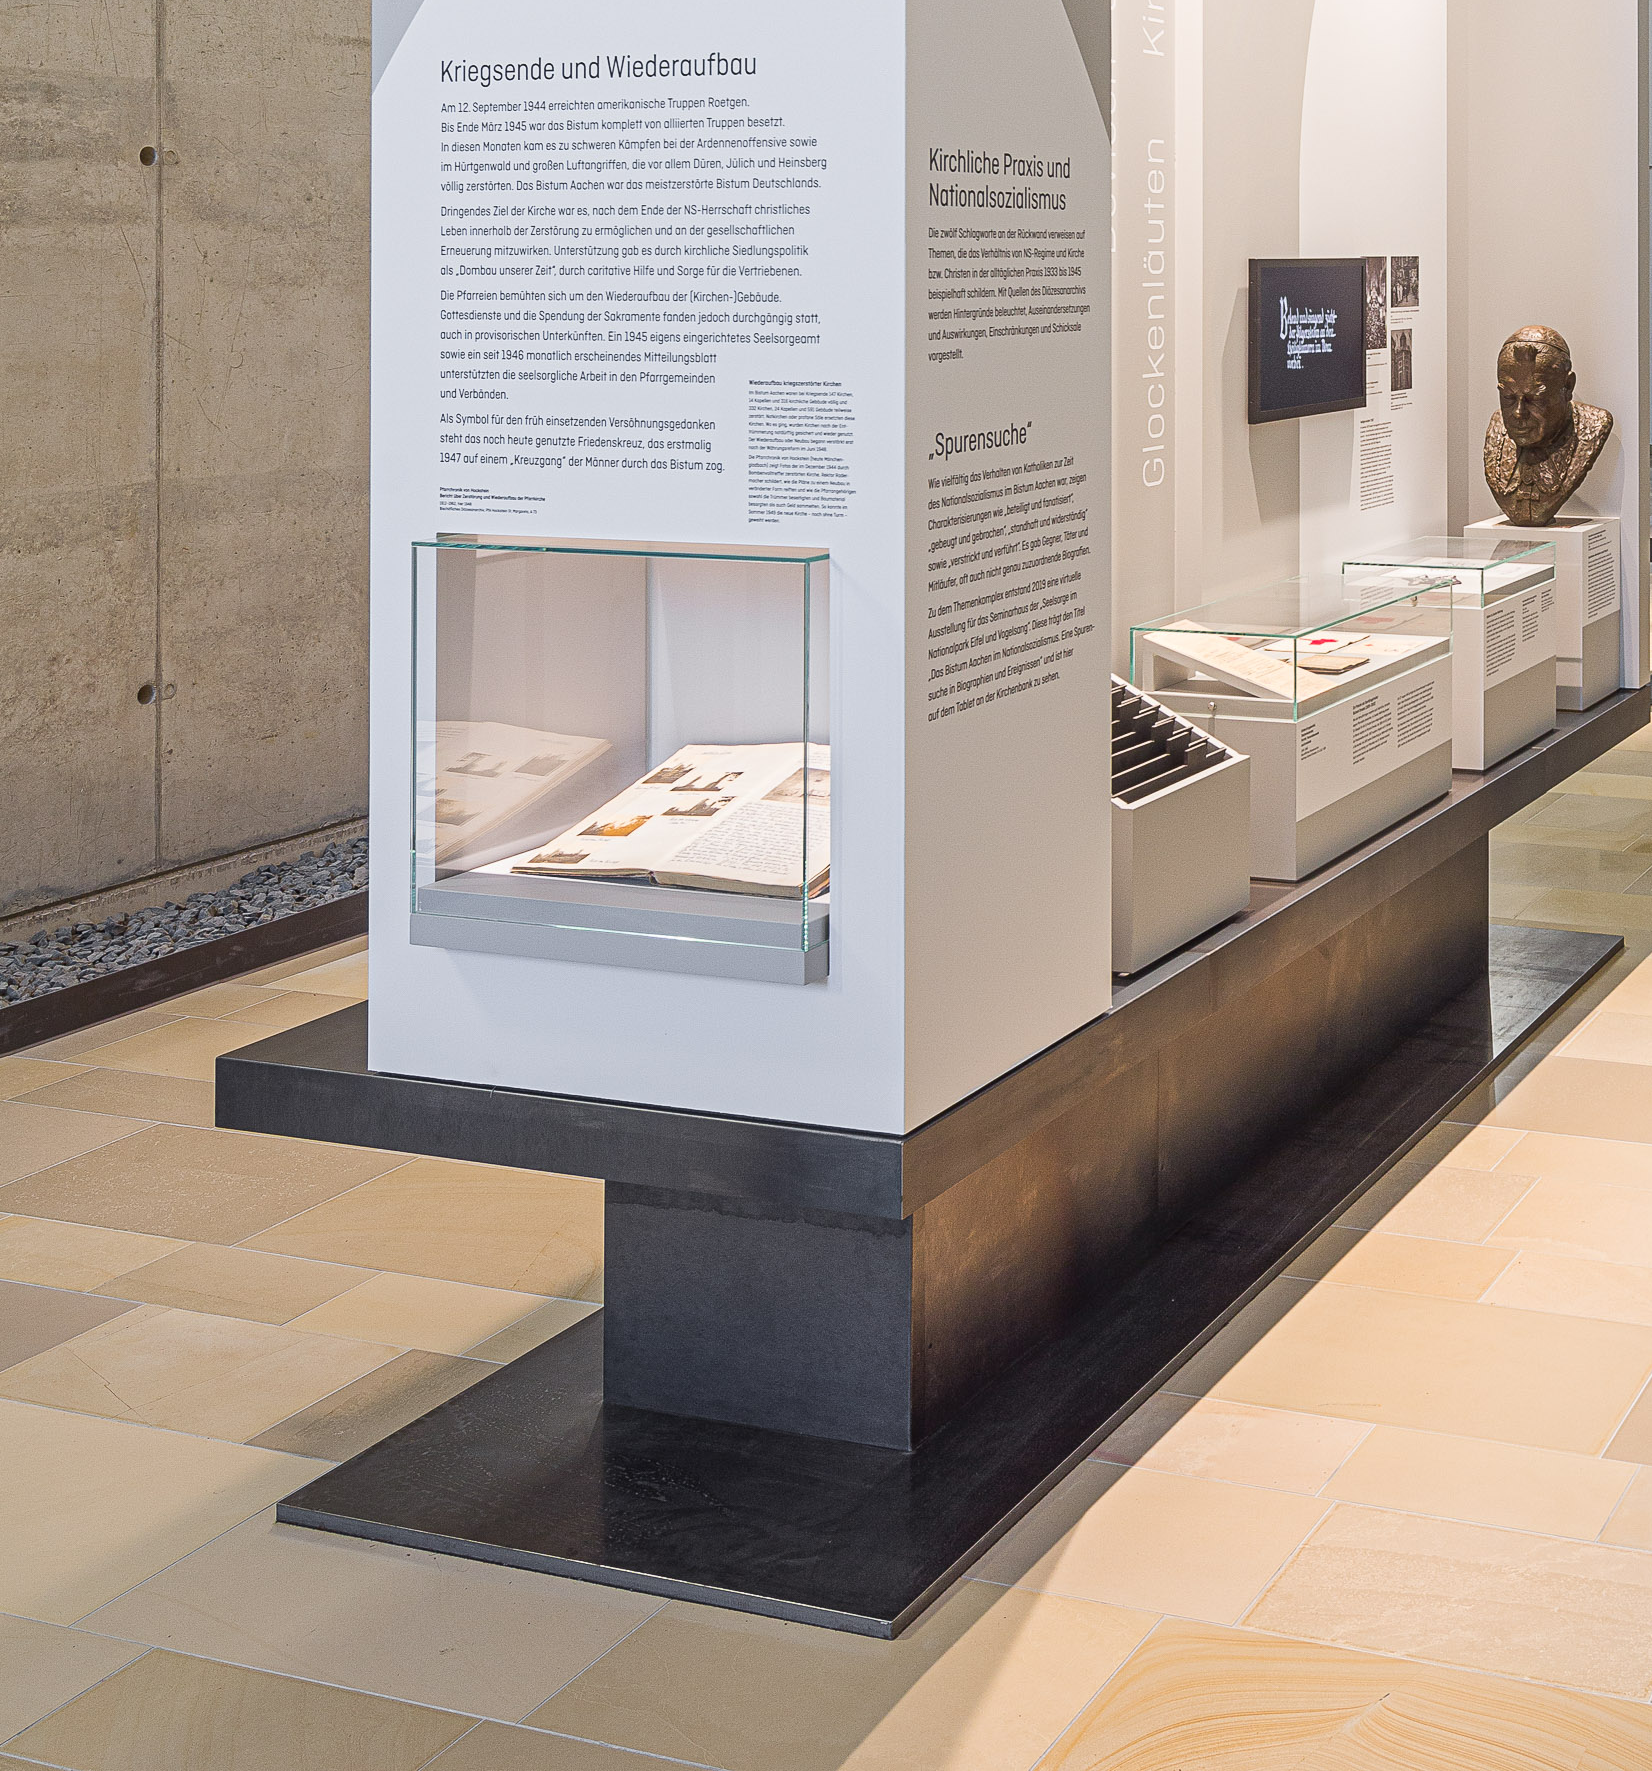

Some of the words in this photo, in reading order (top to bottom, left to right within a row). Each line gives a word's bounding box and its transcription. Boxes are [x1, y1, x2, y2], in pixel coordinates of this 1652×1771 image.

[441, 57, 554, 87] Kriegsende
[562, 55, 599, 79] und
[606, 52, 755, 77] Wiederaufbau
[441, 103, 455, 112] Am
[458, 102, 470, 112] 12.
[472, 101, 521, 114] September
[524, 100, 545, 111] 1944
[548, 100, 594, 110] erreichten
[597, 98, 665, 109] amerikanische
[667, 98, 705, 110] Truppen
[708, 97, 749, 109] Roetgen.
[441, 122, 454, 132] Bis
[457, 122, 478, 132] Ende
[481, 121, 502, 131] März
[505, 120, 526, 131] 1945
[529, 122, 545, 130] war
[548, 120, 564, 130] das
[567, 120, 598, 130] Bistum
[601, 119, 642, 131] komplett
[644, 120, 661, 128] von
[664, 118, 704, 128] alliierten
[706, 117, 744, 129] Truppen
[747, 117, 784, 127] besetzt.
[441, 142, 449, 151] In
[451, 142, 480, 152] diesen
[483, 142, 521, 151] Monaten
[524, 141, 543, 150] kam
[546, 142, 556, 150] es
[559, 142, 569, 150] zu
[571, 140, 615, 150] schweren
[619, 138, 660, 151] Kämpfen
[663, 138, 676, 148] bei
[680, 138, 694, 148] der
[697, 136, 786, 148] Ardennenoffensive
[789, 136, 817, 147] sowie
[441, 162, 451, 171] im
[454, 160, 510, 174] Hürtgenwald
[513, 161, 530, 170] und
[533, 160, 563, 173] großen
[566, 159, 629, 172] Luftangriffen,
[632, 159, 645, 169] die
[648, 161, 662, 169] vor
[665, 159, 690, 168] allem
[693, 158, 723, 169] Düren,
[726, 158, 754, 168] Jülich
[758, 157, 775, 167] und
[778, 157, 826, 169] Heinsberg
[930, 147, 999, 174] Kirchliche
[1004, 153, 1043, 177] Praxis
[1047, 157, 1070, 178] und
[440, 181, 463, 193] völlig
[466, 181, 513, 191] zerstörten.
[516, 180, 533, 190] Das
[536, 180, 567, 190] Bistum
[570, 180, 604, 190] Aachen
[607, 181, 624, 189] war
[626, 179, 642, 189] das
[645, 178, 713, 189] meistzerstörte
[716, 178, 749, 188] Bistum
[753, 177, 821, 188] Deutschlands.
[929, 183, 1066, 210] Nationalsozialismus
[928, 227, 938, 238] Die
[940, 227, 957, 238] zwölf
[958, 228, 996, 241] Schlagworte
[1006, 229, 1016, 238] der
[1017, 228, 1046, 238] Rückwand
[1048, 229, 1074, 239] verweisen
[1076, 229, 1085, 239] auf
[928, 247, 956, 259] Themen,
[957, 248, 967, 258] die
[968, 248, 979, 258] das
[980, 248, 1010, 258] Verhältnis
[1023, 248, 1054, 260] NS-Regime
[1056, 248, 1066, 257] und
[1068, 248, 1084, 257] Kirche
[928, 268, 942, 279] bzw.
[944, 268, 970, 278] Christen
[972, 268, 977, 277] in
[979, 268, 989, 277] der
[990, 267, 1024, 280] alltäglichen
[1026, 267, 1042, 276] Praxis
[1044, 267, 1058, 276] 1933
[1059, 266, 1067, 276] bis
[1068, 266, 1081, 276] 1945
[1142, 138, 1165, 487] Glockenläuten
[928, 348, 963, 363] vorgestellt.
[440, 413, 453, 423] Als
[455, 413, 488, 425] Symbol
[491, 414, 504, 424] für
[506, 414, 522, 425] den
[525, 415, 543, 425] früh
[546, 415, 606, 426] einsetzenden
[609, 417, 715, 431] Versöhnungsgedanken
[440, 433, 462, 443] steht
[465, 433, 480, 443] das
[483, 434, 504, 444] noch
[507, 434, 532, 445] heute
[535, 437, 575, 448] genutzte
[578, 436, 644, 449] Friedenskreuz,
[647, 438, 664, 448] das
[667, 439, 711, 452] erstmalig
[440, 452, 461, 462] 1947
[463, 453, 478, 463] auf
[480, 453, 507, 464] einem
[568, 456, 583, 466] der
[585, 456, 619, 467] Männer
[621, 458, 647, 468] durch
[650, 458, 667, 469] das
[670, 459, 703, 469] Bistum
[705, 462, 724, 473] zog.
